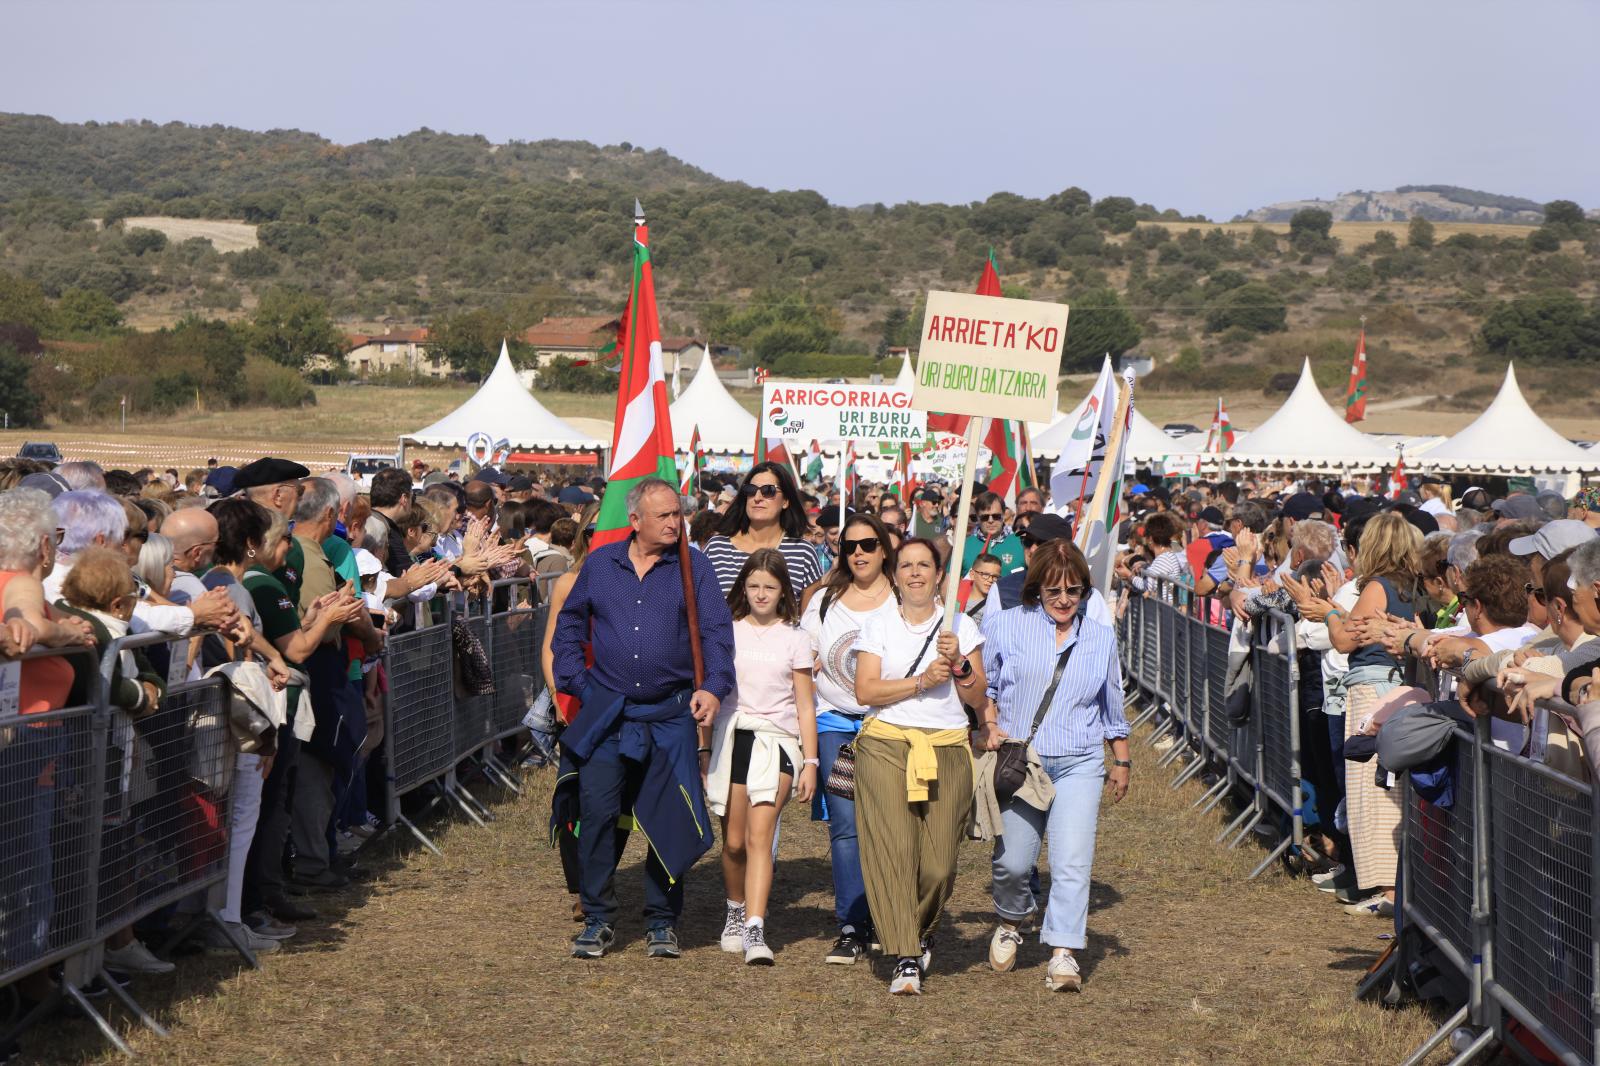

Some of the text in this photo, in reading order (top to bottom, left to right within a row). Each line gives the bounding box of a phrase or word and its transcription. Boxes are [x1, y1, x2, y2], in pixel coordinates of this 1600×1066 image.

[920, 361, 1047, 399] URI BURU BATZARRA
[839, 411, 911, 425] URI BURU
[839, 425, 922, 438] BATZARRA
